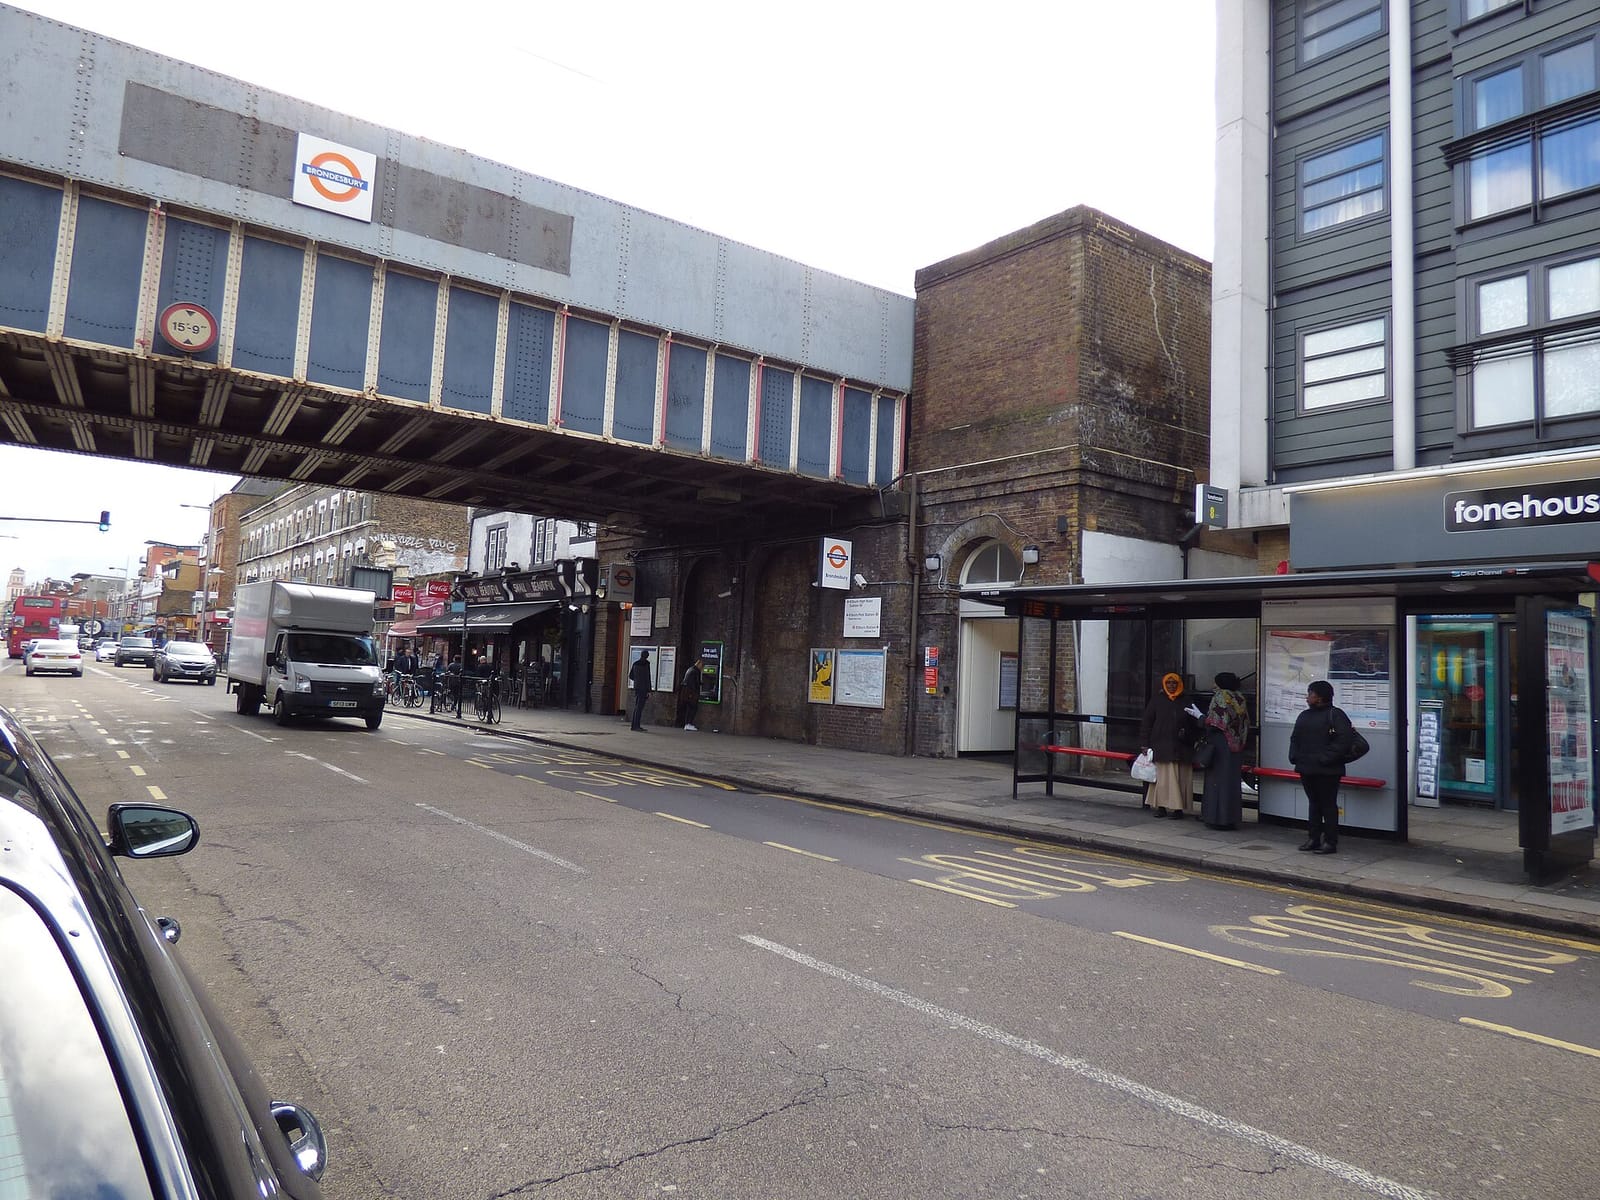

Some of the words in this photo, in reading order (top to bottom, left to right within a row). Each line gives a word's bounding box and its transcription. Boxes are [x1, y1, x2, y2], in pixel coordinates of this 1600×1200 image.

[306, 166, 364, 188] BRONDESBURY
[896, 847, 1190, 900] STOP
[1206, 904, 1581, 998] BUS
